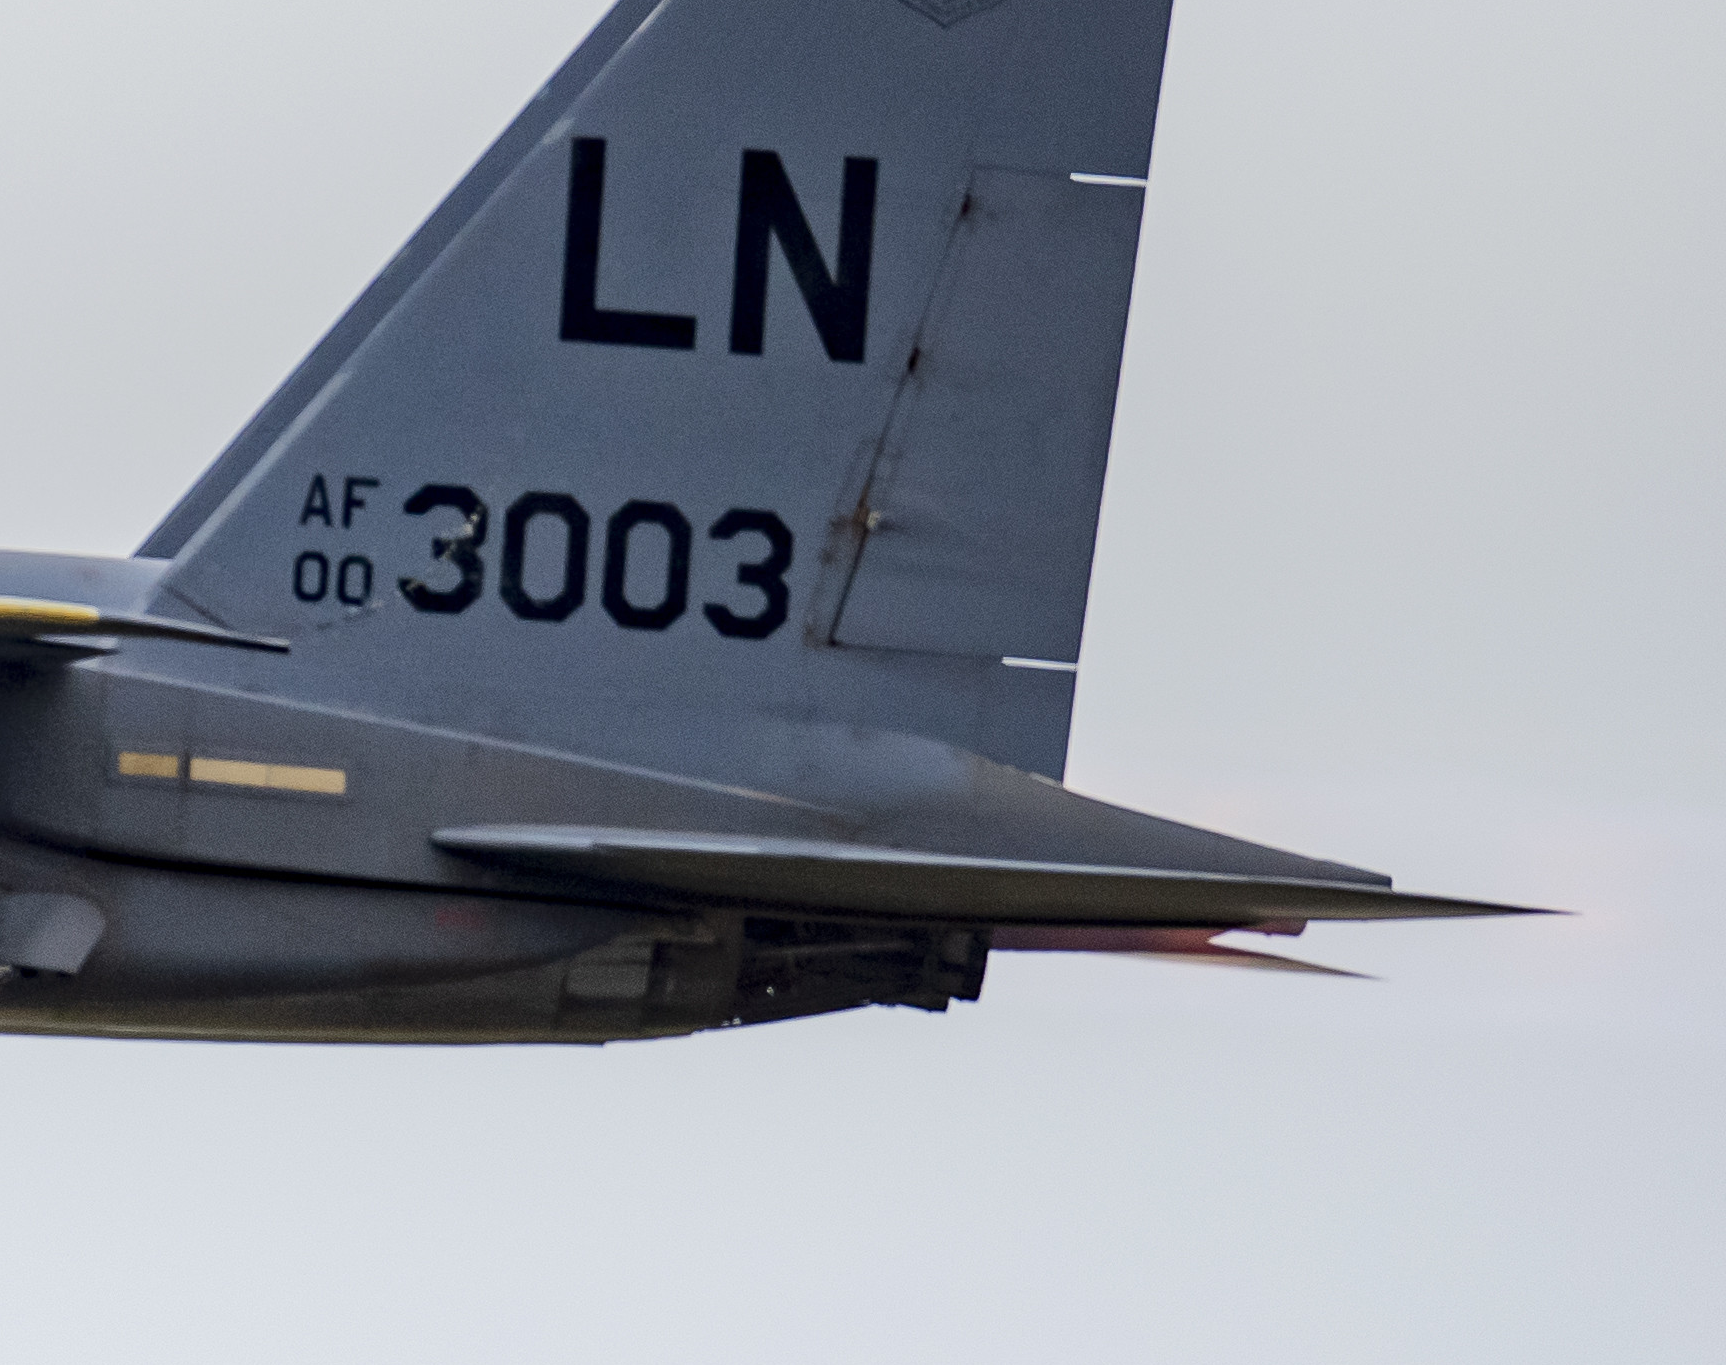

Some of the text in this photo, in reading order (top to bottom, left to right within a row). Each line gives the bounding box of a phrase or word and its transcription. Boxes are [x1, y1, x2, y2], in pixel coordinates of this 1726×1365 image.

[559, 136, 878, 363] LN
[299, 473, 380, 529] AF
[294, 550, 373, 607] 00
[397, 484, 794, 640] 3003
